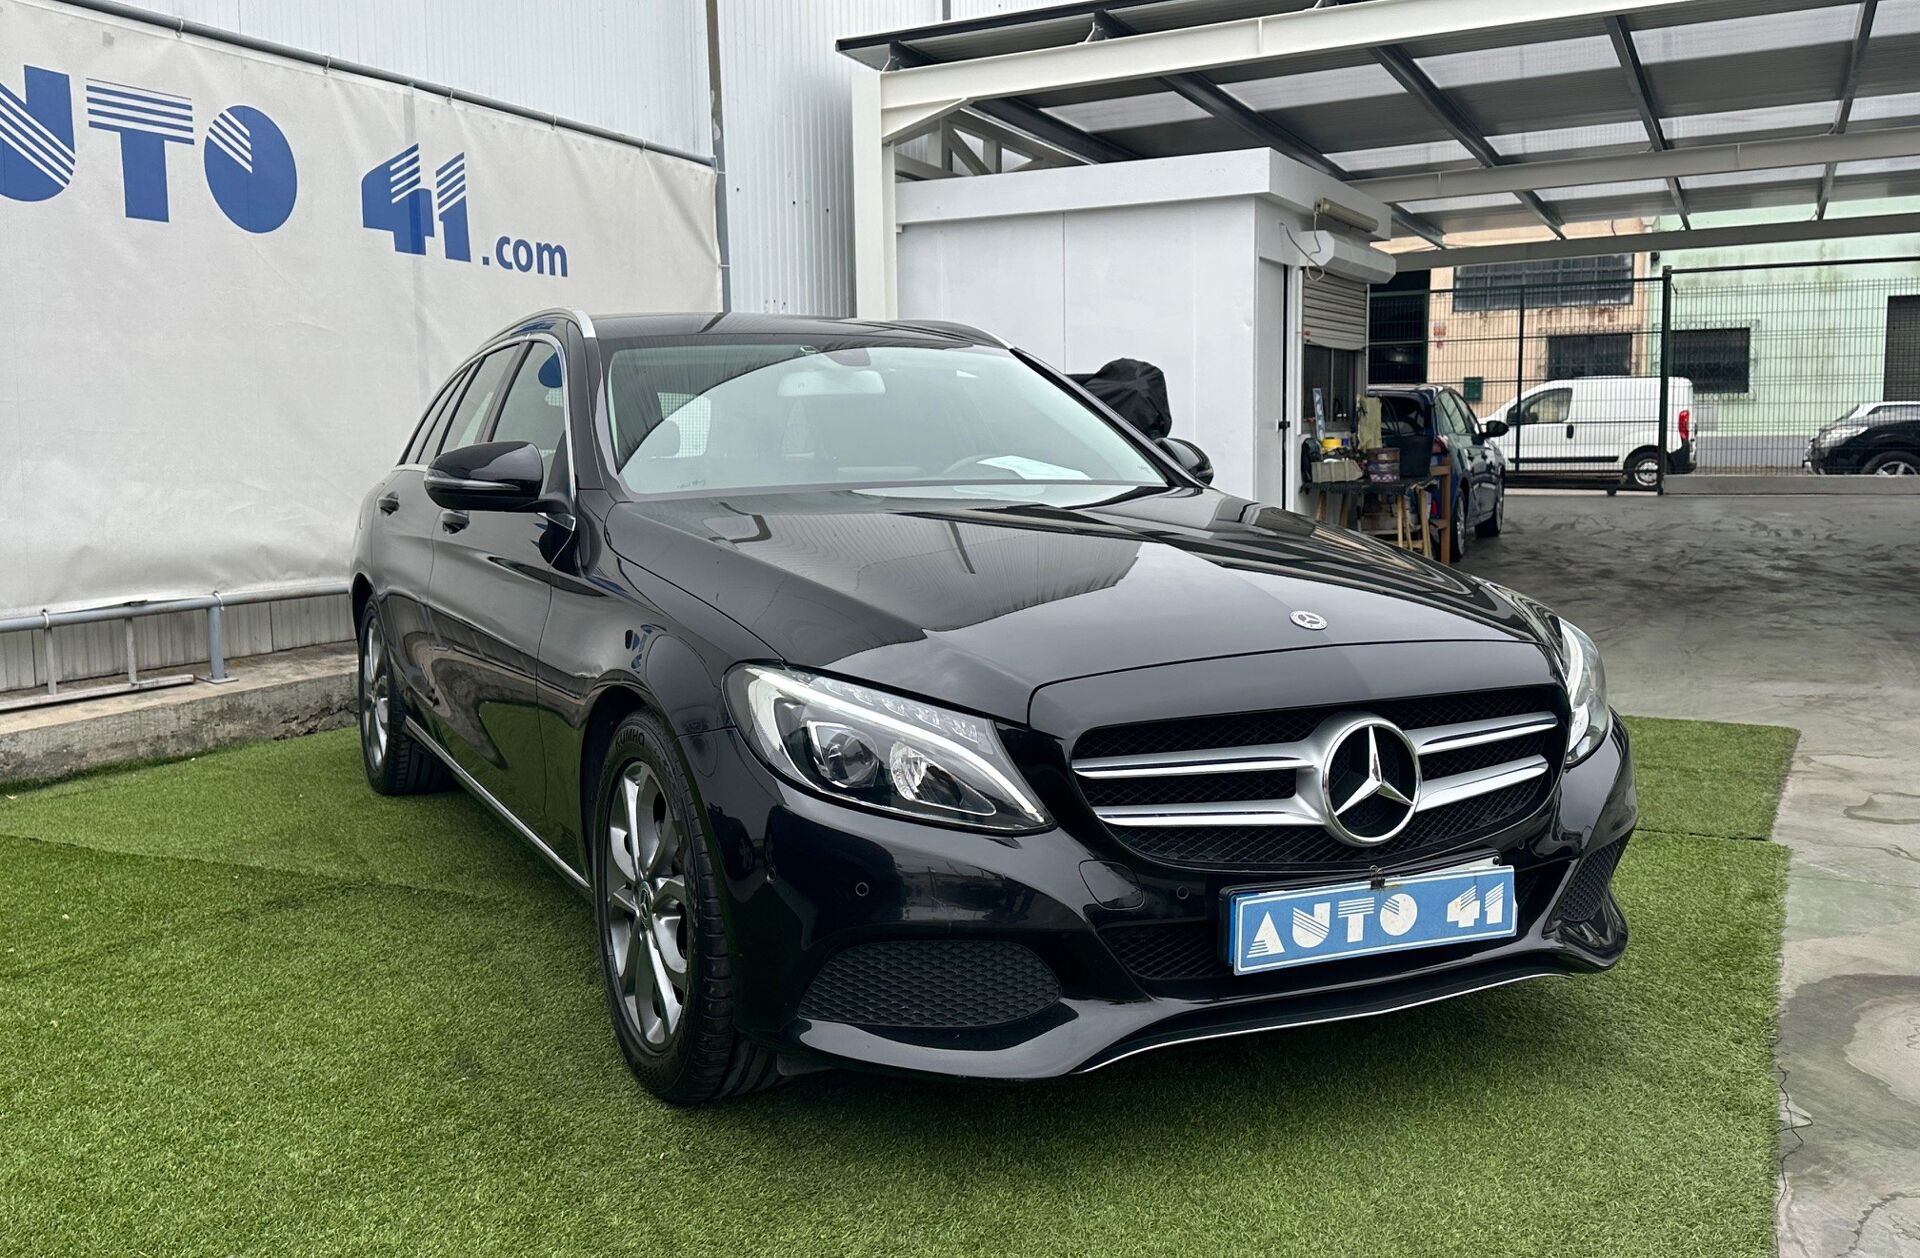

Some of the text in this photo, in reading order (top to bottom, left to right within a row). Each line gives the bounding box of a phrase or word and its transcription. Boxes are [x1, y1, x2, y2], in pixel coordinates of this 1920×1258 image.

[615, 728, 645, 752] KUMHO
[1246, 882, 1505, 958] AUTO 41
